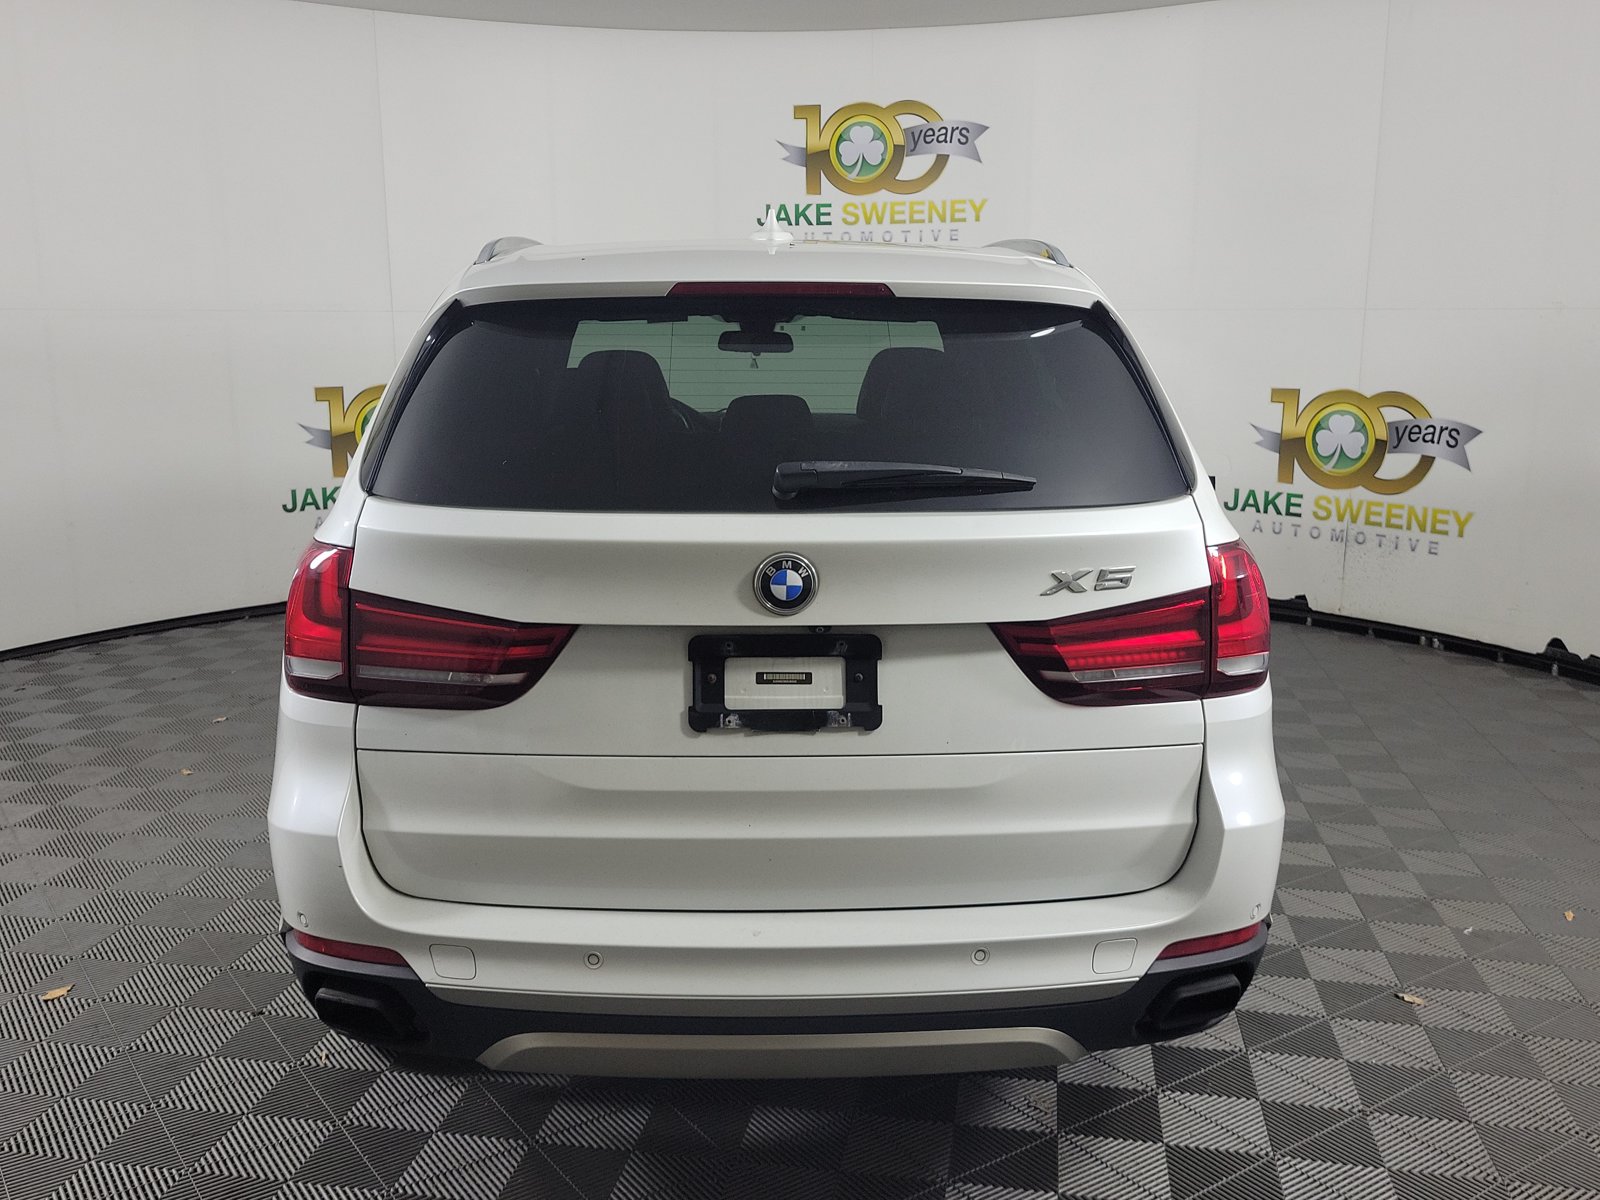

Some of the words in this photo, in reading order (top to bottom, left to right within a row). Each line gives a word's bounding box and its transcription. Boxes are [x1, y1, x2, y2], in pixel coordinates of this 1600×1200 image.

[793, 100, 950, 196] 100
[910, 125, 970, 152] years
[757, 203, 833, 227] JAKE
[841, 198, 989, 226] SWEENEY
[790, 228, 960, 243] UTOMOTIVE
[1270, 388, 1436, 496] 100
[1392, 423, 1461, 449] years
[1223, 488, 1304, 518] JAKE
[1312, 495, 1475, 538] SWEENEY
[1251, 519, 1441, 556] AUTOMOTIVE
[766, 560, 809, 577] BMW
[1039, 565, 1137, 597] X5
